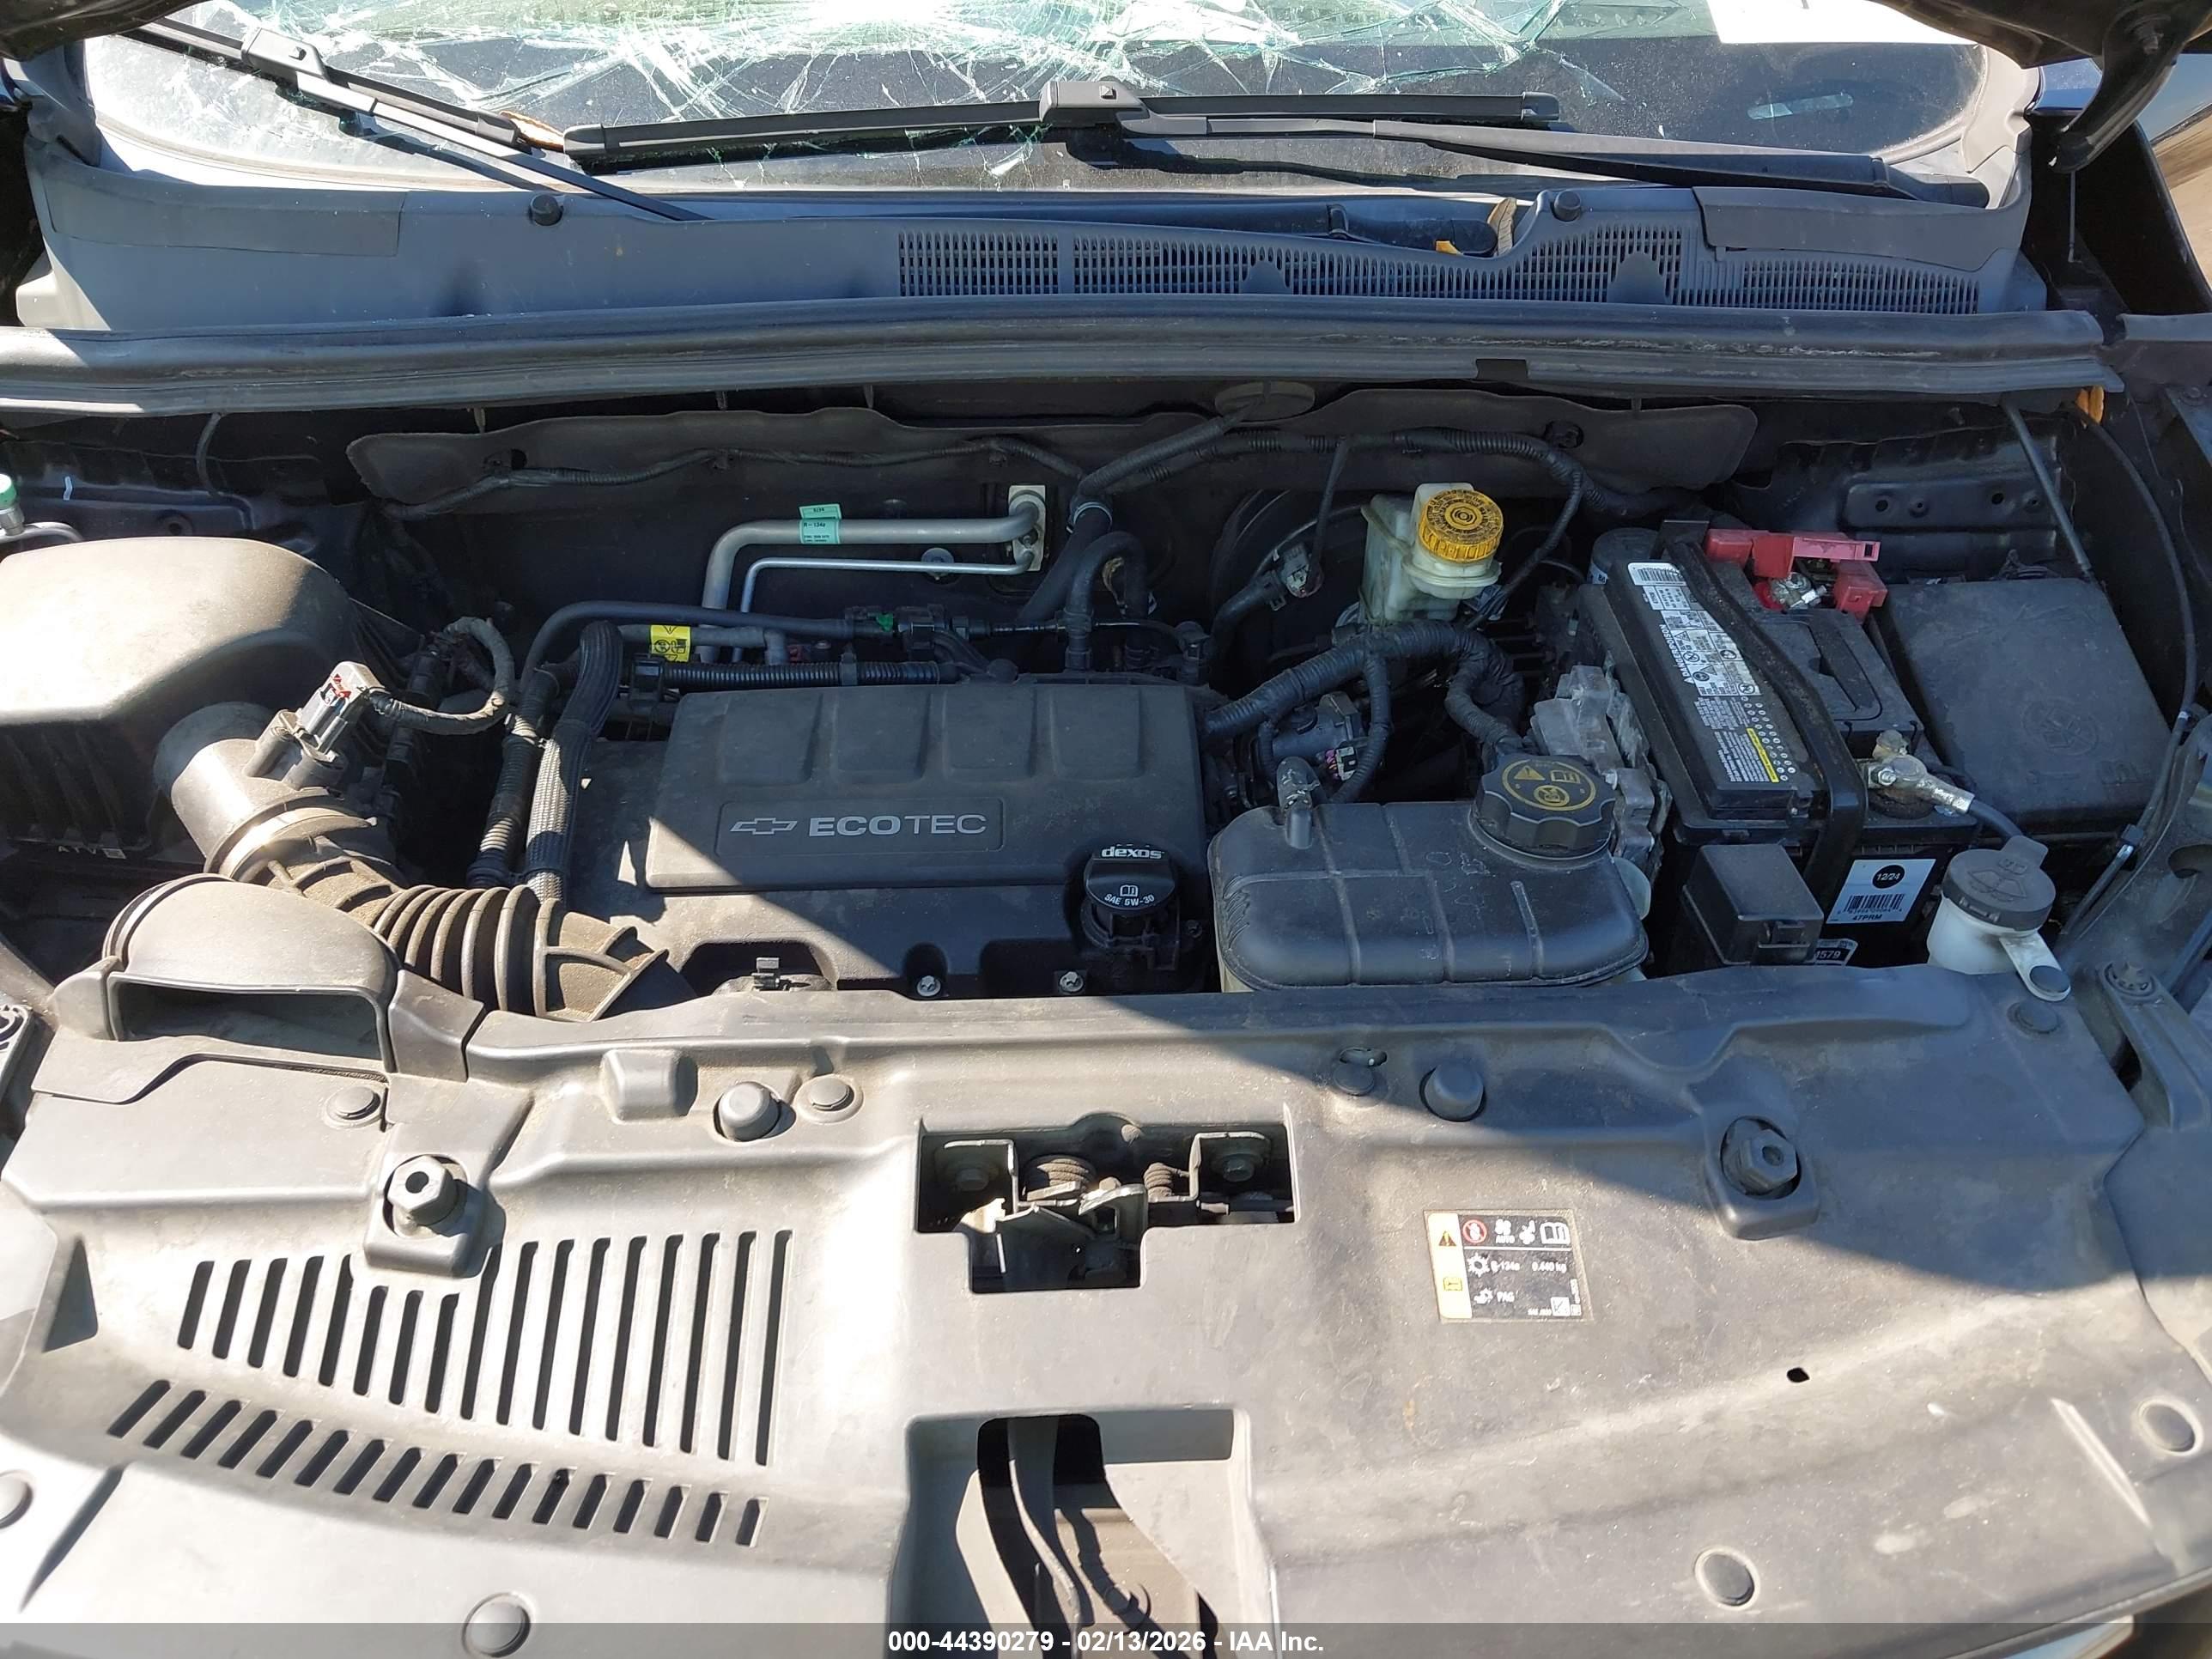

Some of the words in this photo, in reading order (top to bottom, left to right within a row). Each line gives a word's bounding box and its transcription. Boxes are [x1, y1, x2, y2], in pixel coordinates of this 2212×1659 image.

[809, 814, 988, 836] ECOTEC
[1102, 847, 1161, 859] dexos
[1104, 894, 1122, 905] SAE
